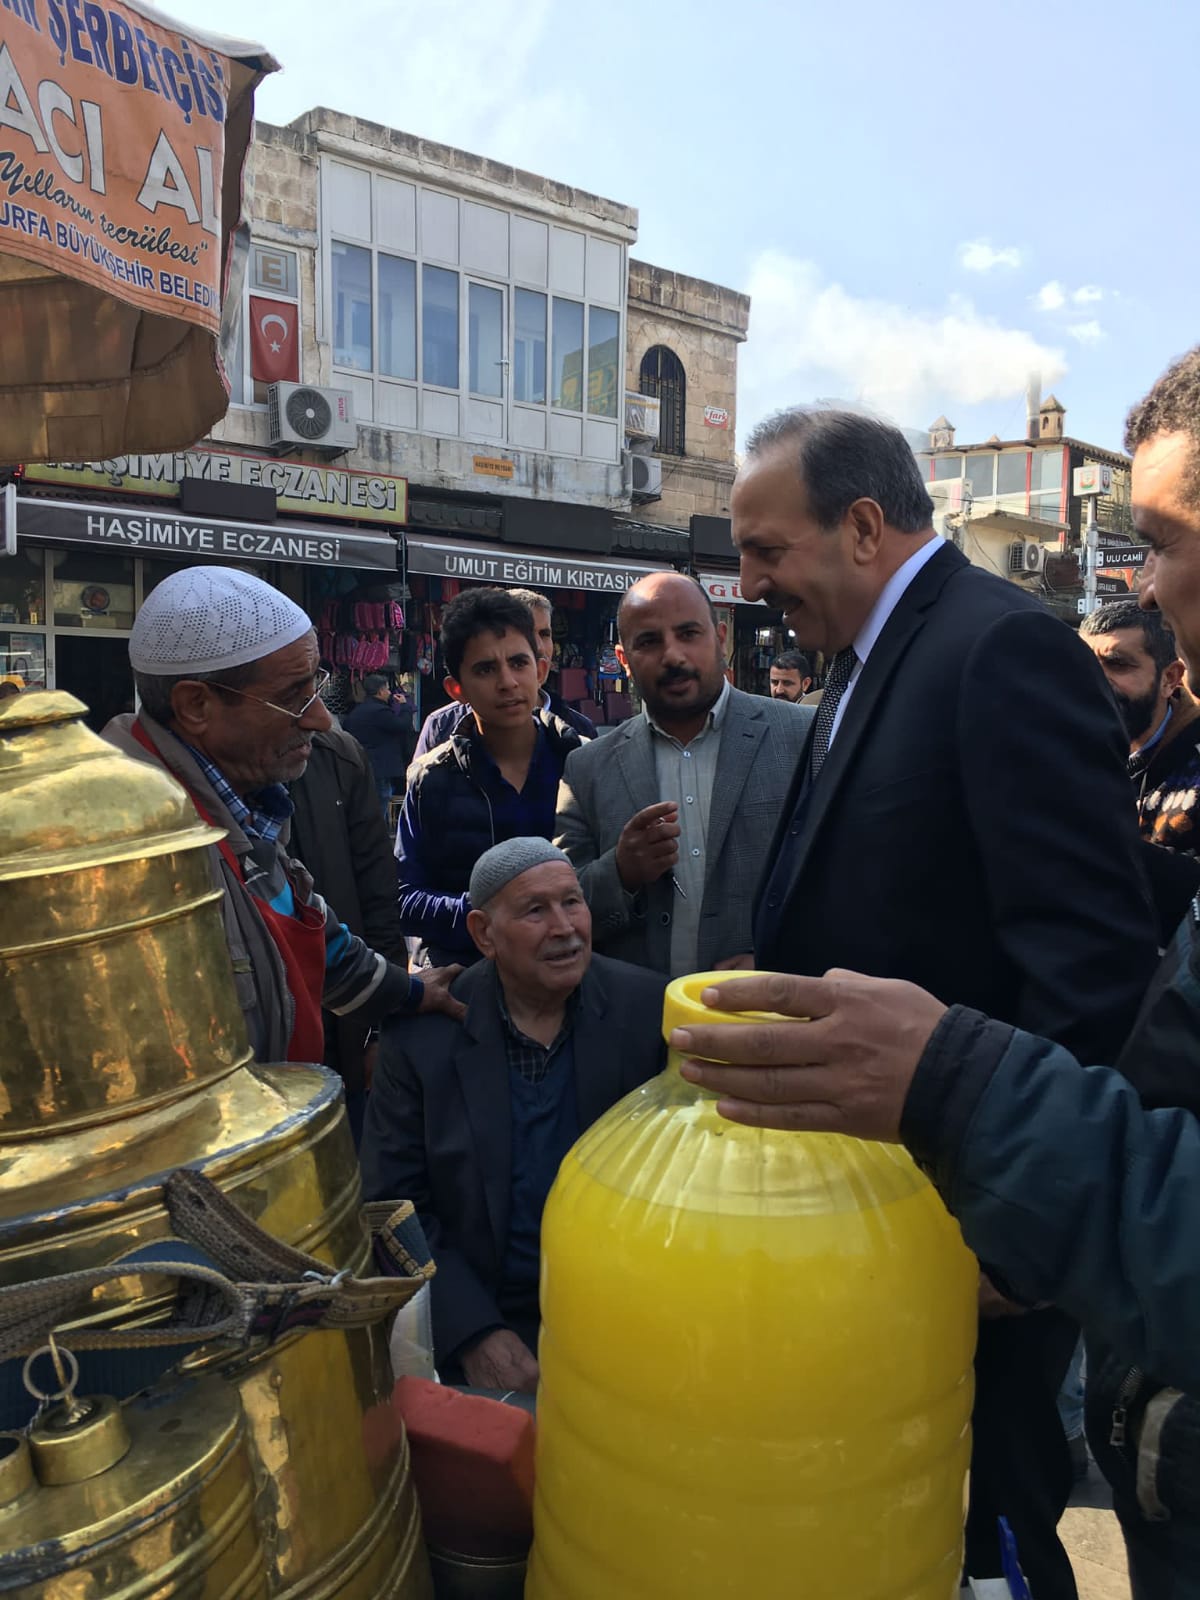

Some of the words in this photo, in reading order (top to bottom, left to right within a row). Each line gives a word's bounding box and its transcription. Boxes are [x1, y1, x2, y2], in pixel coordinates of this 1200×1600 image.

[56, 221, 156, 290] BÜYÜKŞEHİR
[261, 255, 282, 285] E
[240, 458, 397, 511] ECZANESİ
[87, 515, 215, 549] HAŞİMİYE
[223, 532, 341, 561] ECZANESİ
[1106, 554, 1121, 563] ULU
[1122, 551, 1143, 562] CAMİİ
[445, 556, 498, 577] UMUT
[502, 562, 562, 585] EĞİTİM
[567, 571, 643, 591] KIRTASİY
